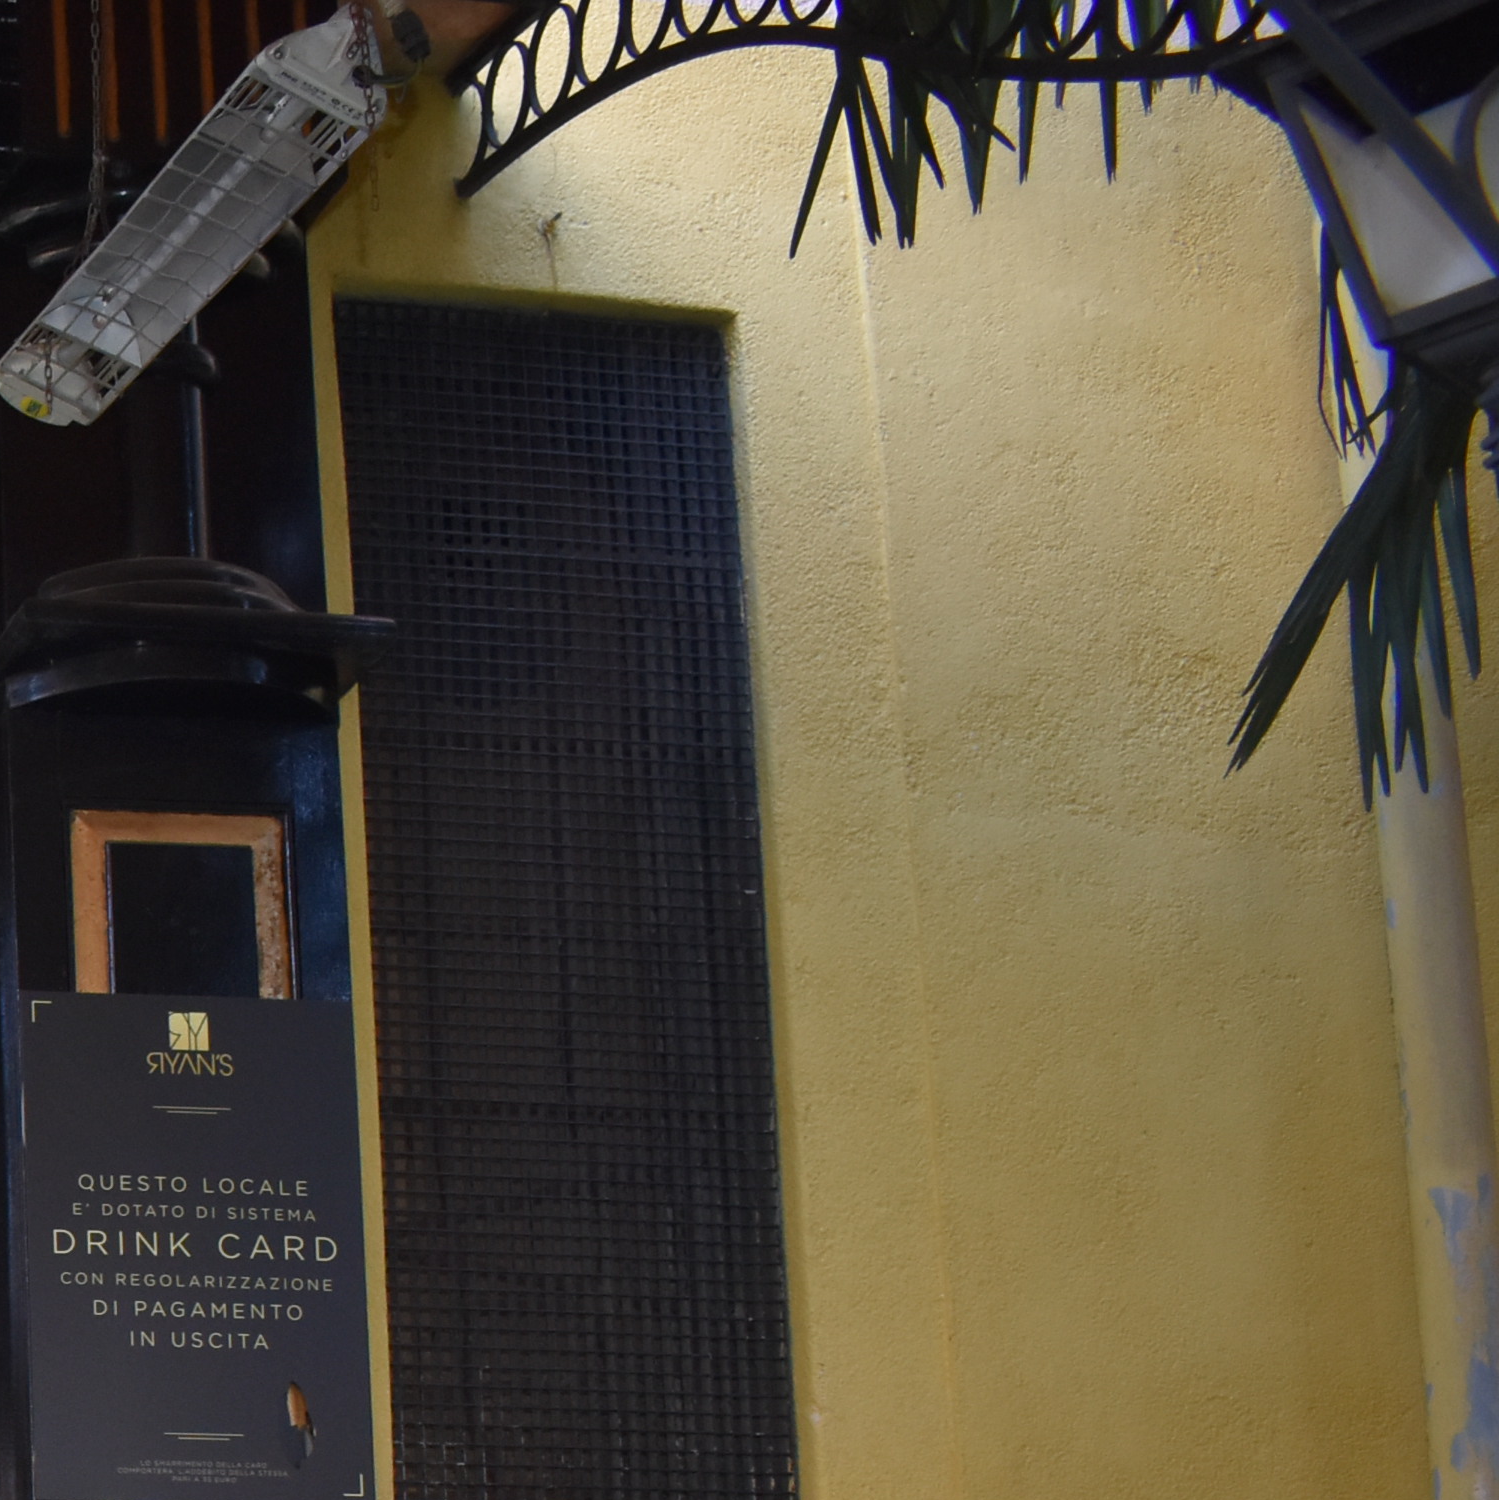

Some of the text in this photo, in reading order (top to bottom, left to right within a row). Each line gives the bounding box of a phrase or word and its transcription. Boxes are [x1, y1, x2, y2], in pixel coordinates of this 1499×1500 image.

[78, 1174, 308, 1197] QUESTO LOCALE
[72, 1203, 316, 1222] E' DOTATO DI SISTEMA
[53, 1229, 337, 1262] DRINK CARD
[60, 1272, 333, 1292] CON REGOLARIZZAZIONE
[93, 1300, 303, 1321] DI PAGAMENTO
[130, 1331, 269, 1350] IN USCITA
